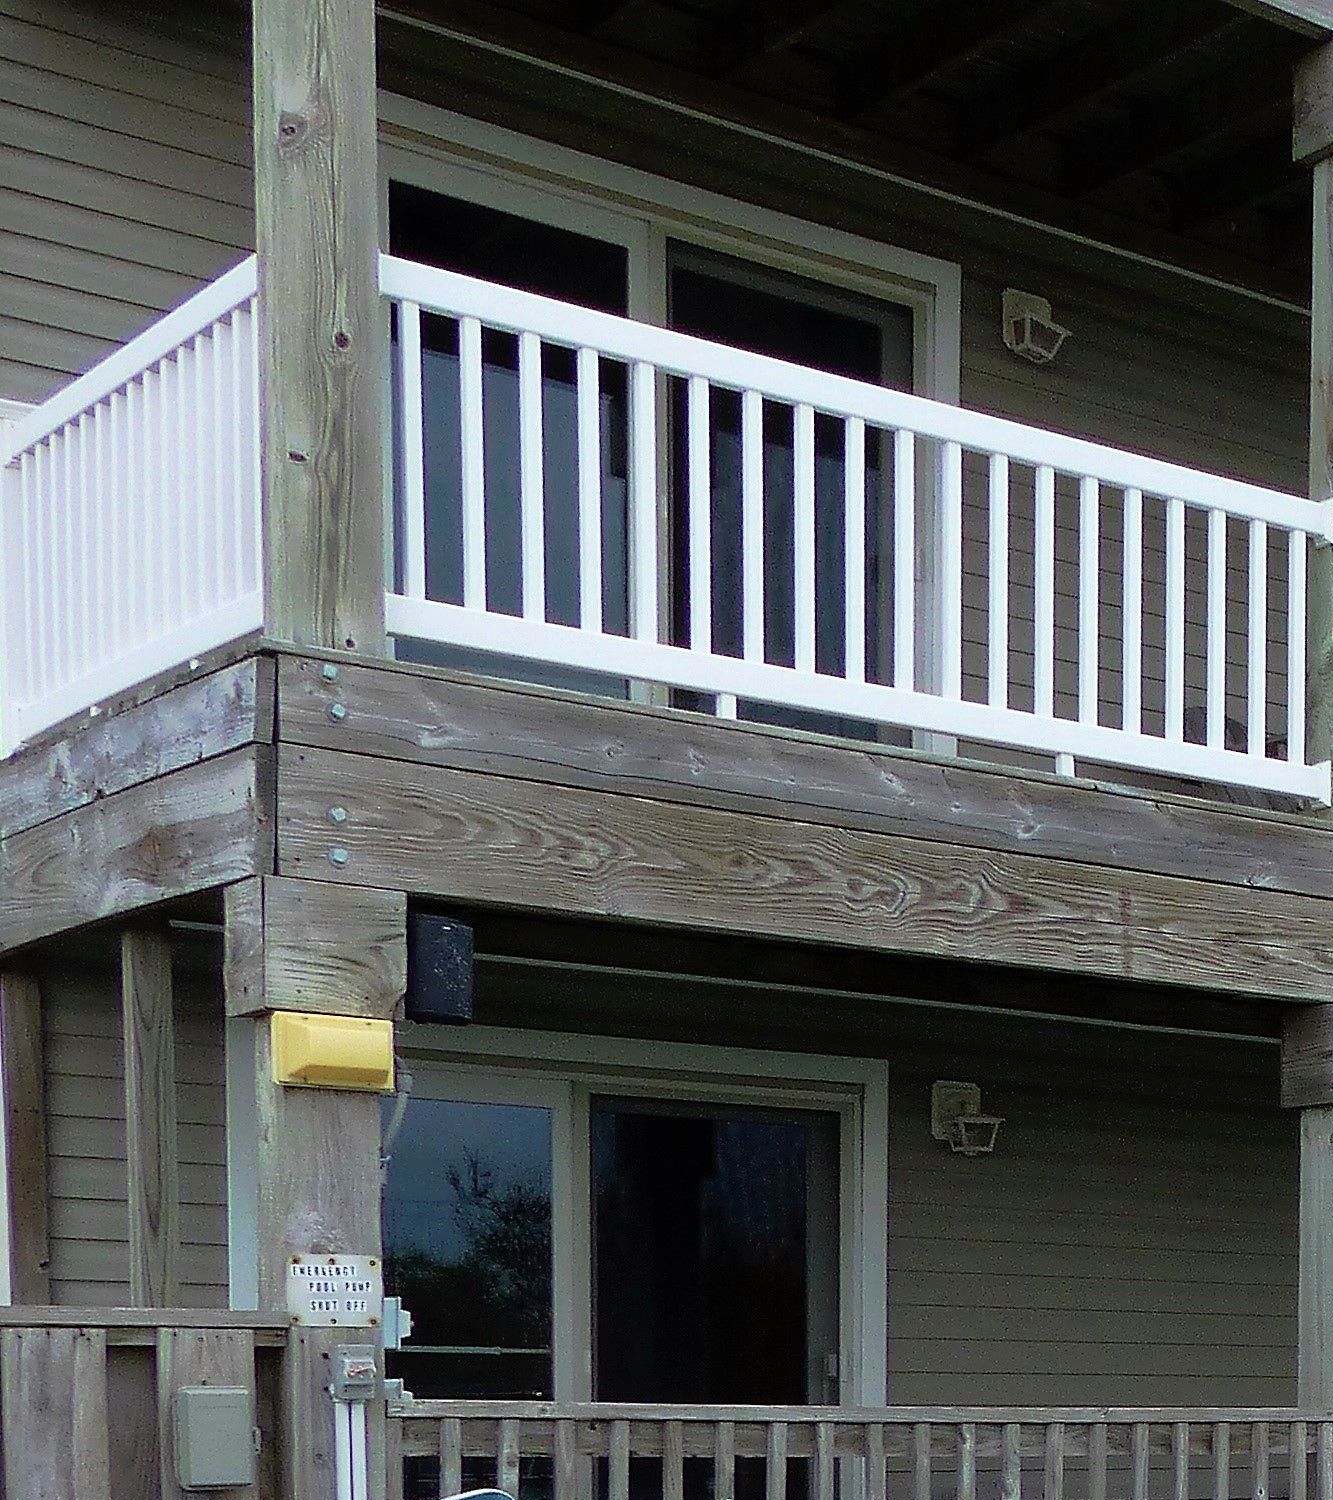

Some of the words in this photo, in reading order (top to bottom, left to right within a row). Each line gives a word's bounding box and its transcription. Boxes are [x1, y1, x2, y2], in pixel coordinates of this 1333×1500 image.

[345, 1281, 371, 1292] PUMP
[311, 1300, 337, 1311] SHUT
[346, 1300, 366, 1311] OFF
